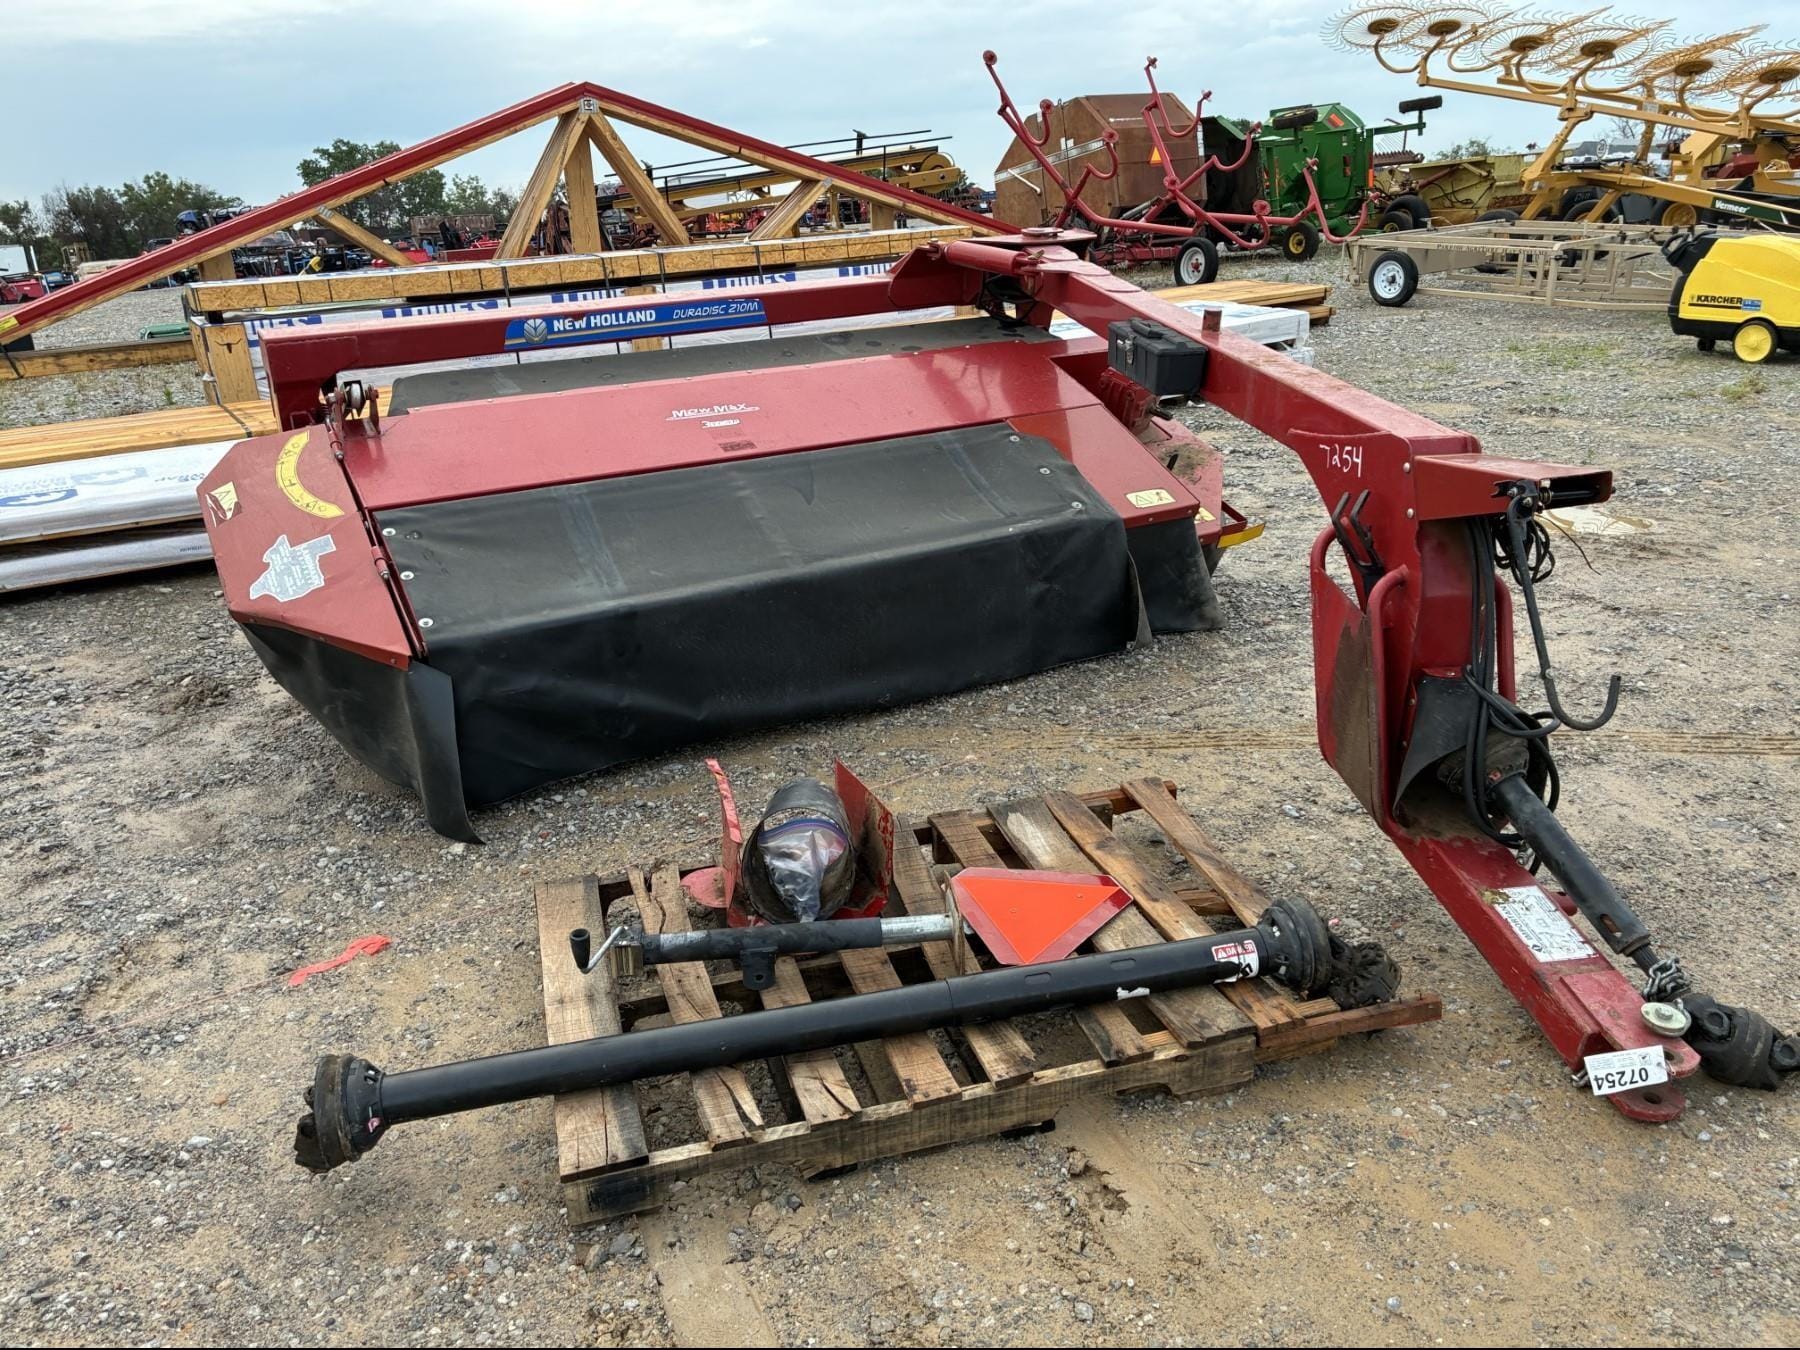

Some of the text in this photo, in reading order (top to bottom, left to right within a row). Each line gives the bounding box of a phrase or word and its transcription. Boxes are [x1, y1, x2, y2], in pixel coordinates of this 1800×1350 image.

[1715, 199, 1748, 214] Vermeer
[553, 309, 656, 332] NEW HOLLAND
[672, 301, 758, 319] DURADISC 210M
[1319, 443, 1363, 478] 7254
[1593, 1067, 1649, 1091] 07254
